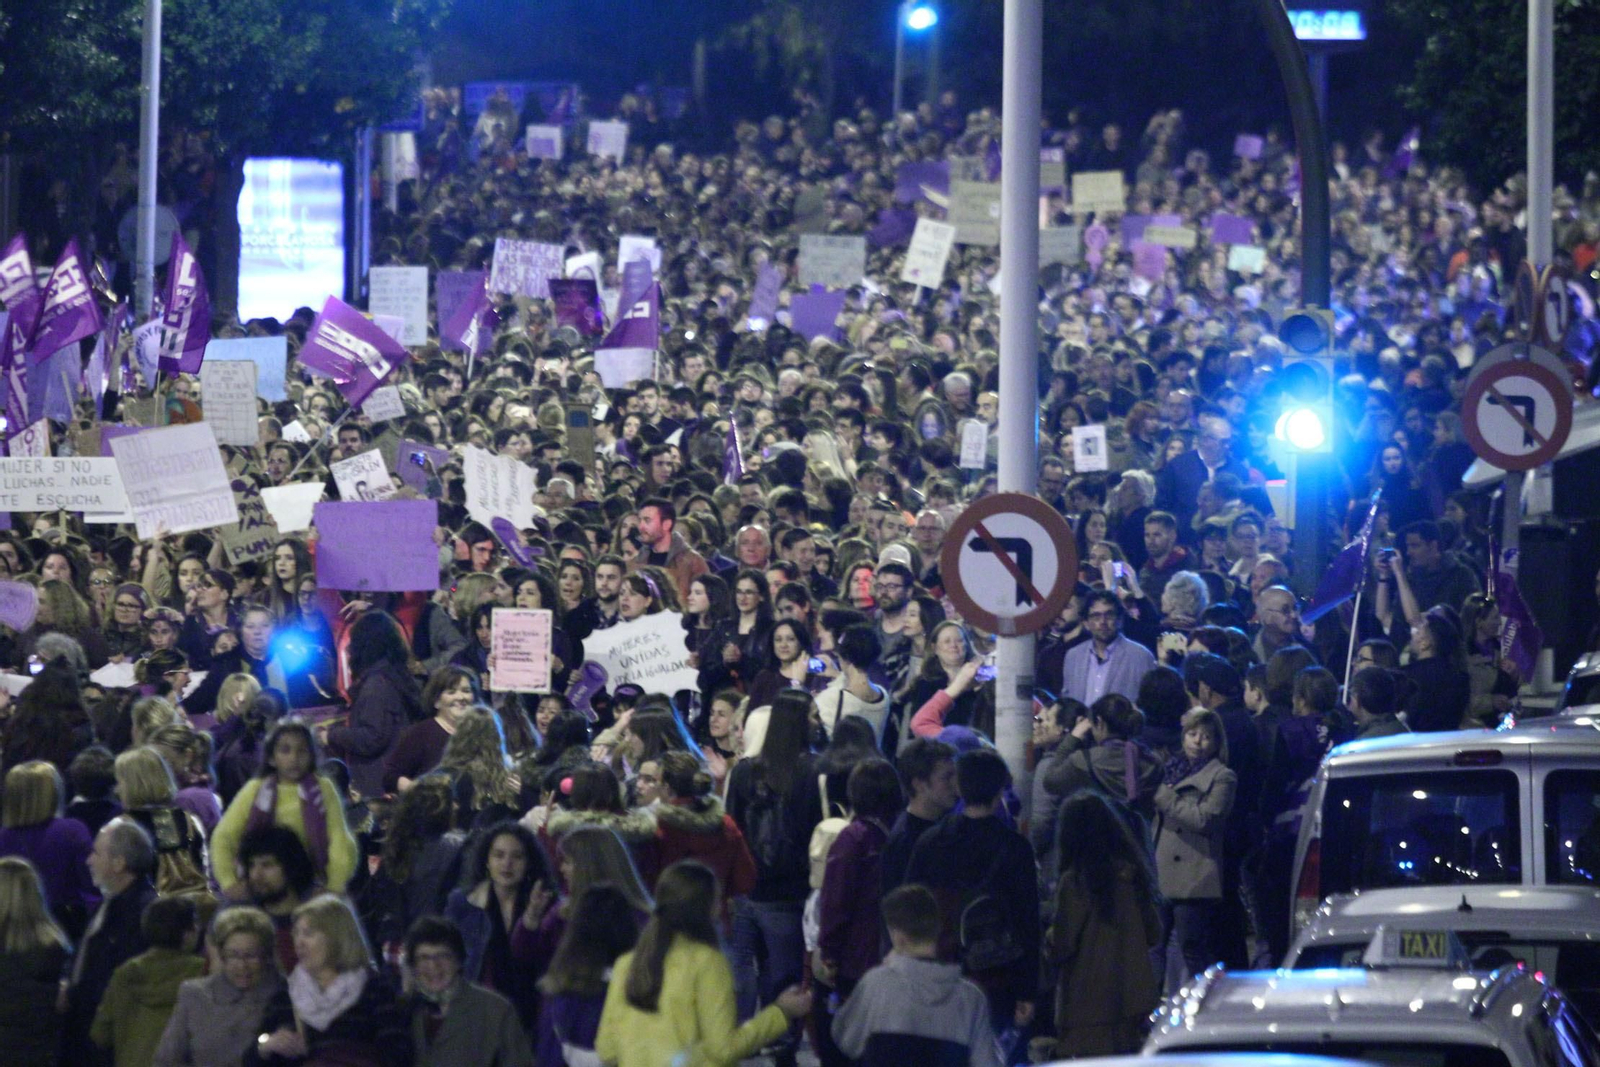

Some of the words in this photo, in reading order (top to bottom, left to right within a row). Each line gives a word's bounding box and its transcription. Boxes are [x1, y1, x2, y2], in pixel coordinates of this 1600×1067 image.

[53, 460, 65, 474] SI
[71, 460, 92, 474] NO
[70, 475, 112, 487] NADIE
[0, 494, 19, 506] TE
[36, 494, 102, 506] ESCUCHA
[608, 632, 662, 659] MUJERES
[619, 645, 670, 670] UNIDAS
[1402, 932, 1445, 958] TAXI
